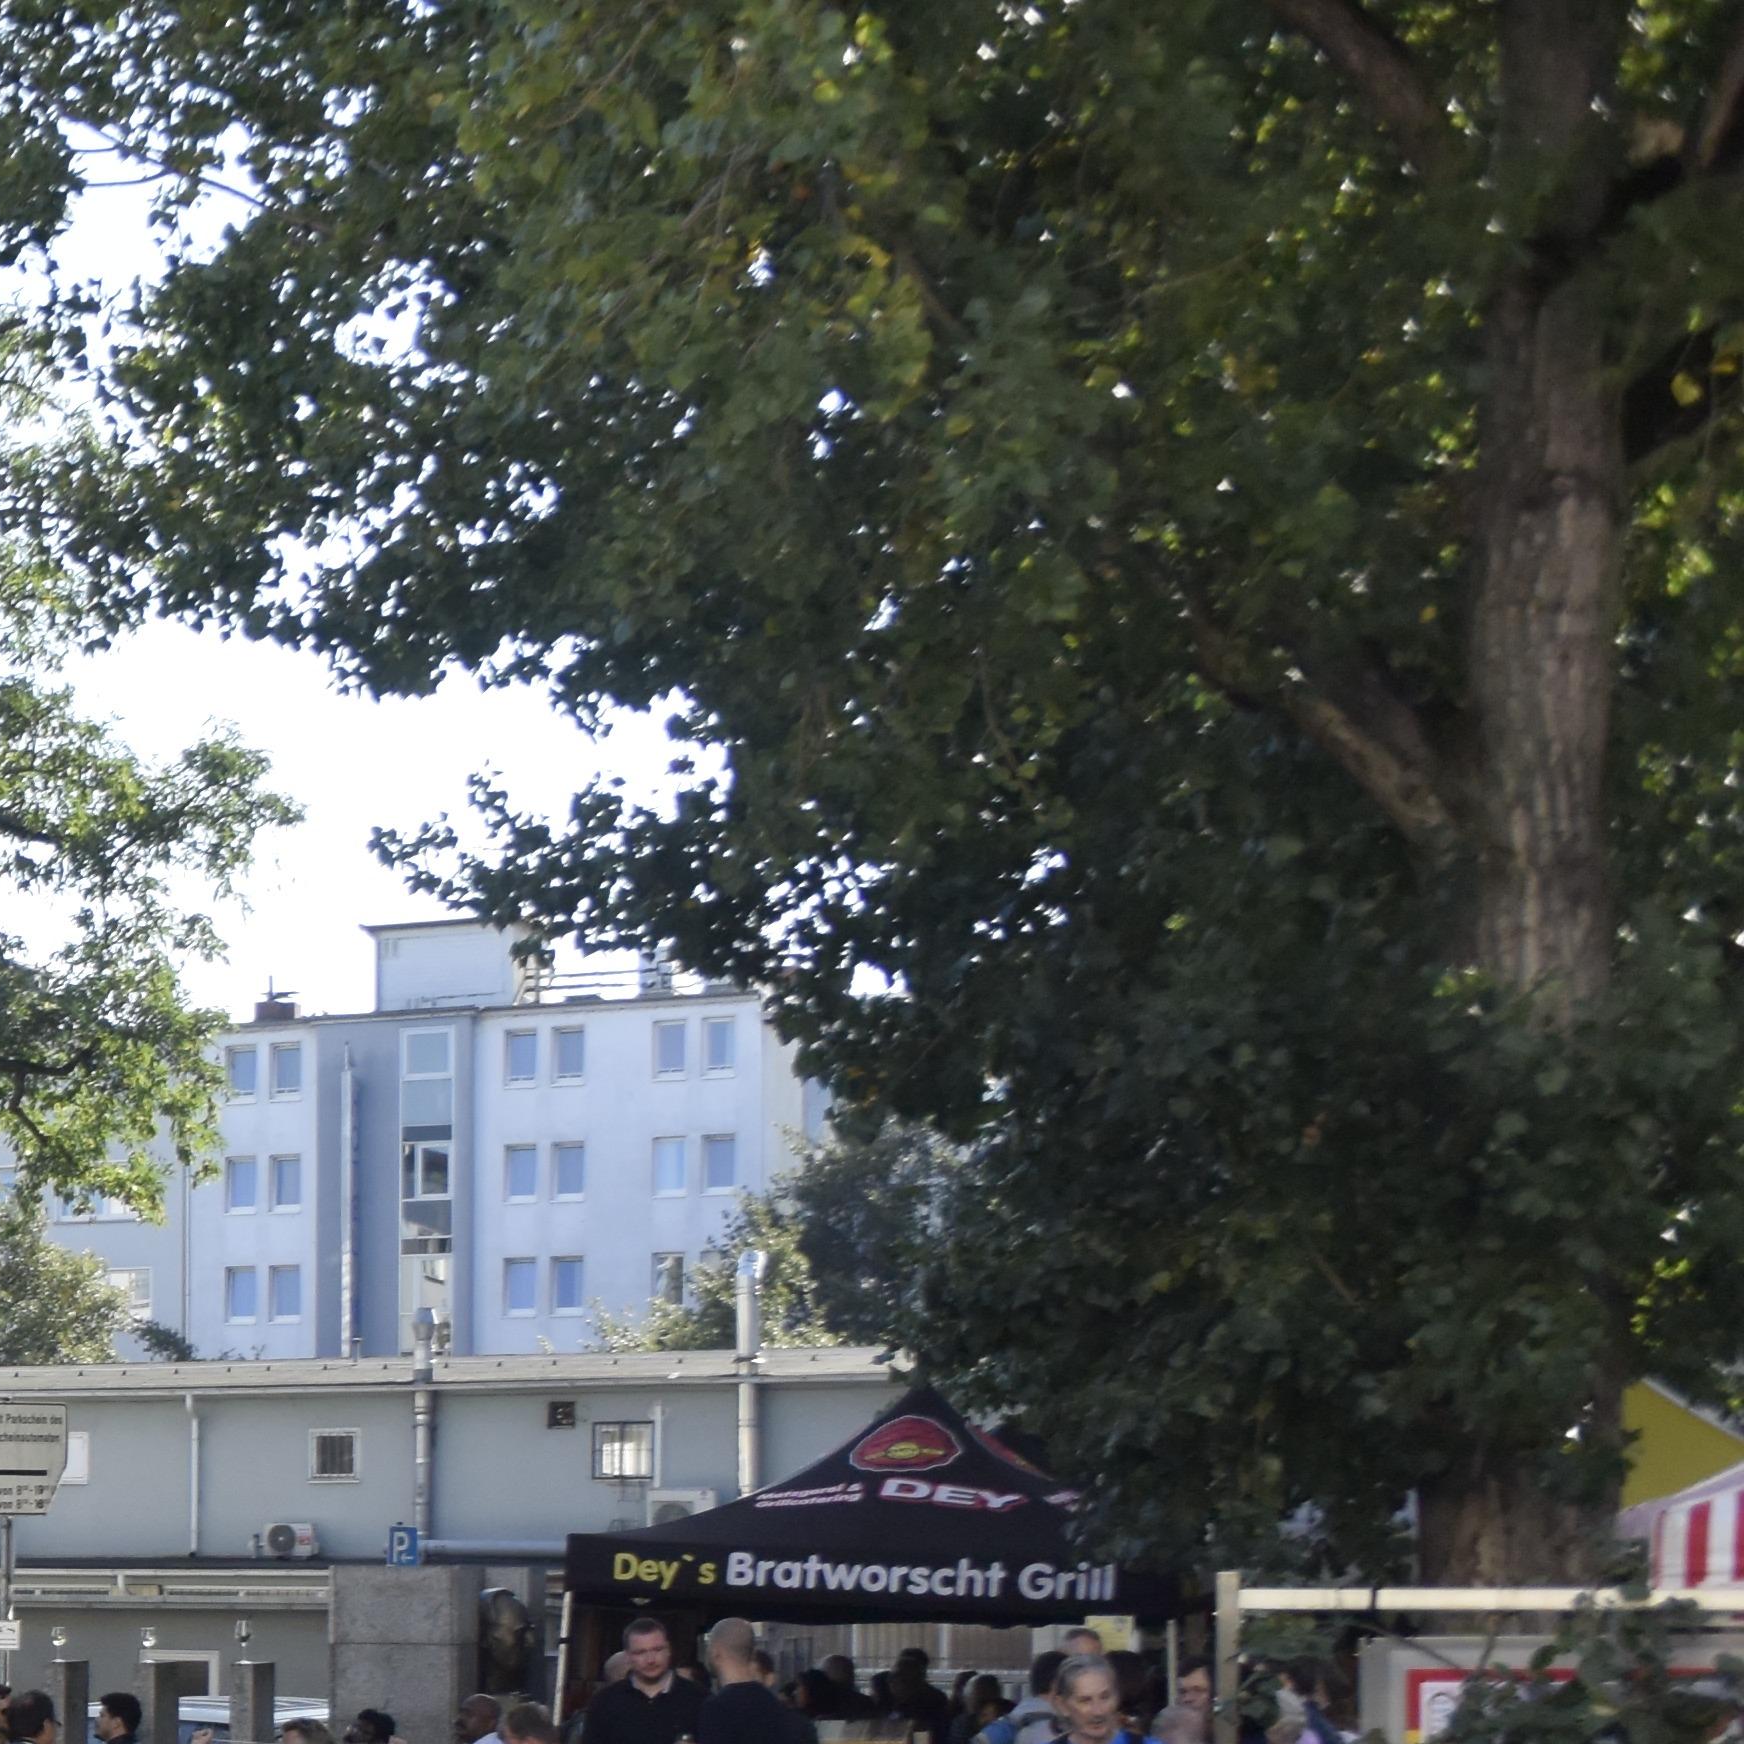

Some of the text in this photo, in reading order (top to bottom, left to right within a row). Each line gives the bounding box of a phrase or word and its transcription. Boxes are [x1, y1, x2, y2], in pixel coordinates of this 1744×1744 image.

[881, 1477, 1025, 1509] DEY
[725, 1551, 1006, 1599] Bratworscht
[1018, 1562, 1118, 1602] Grill
